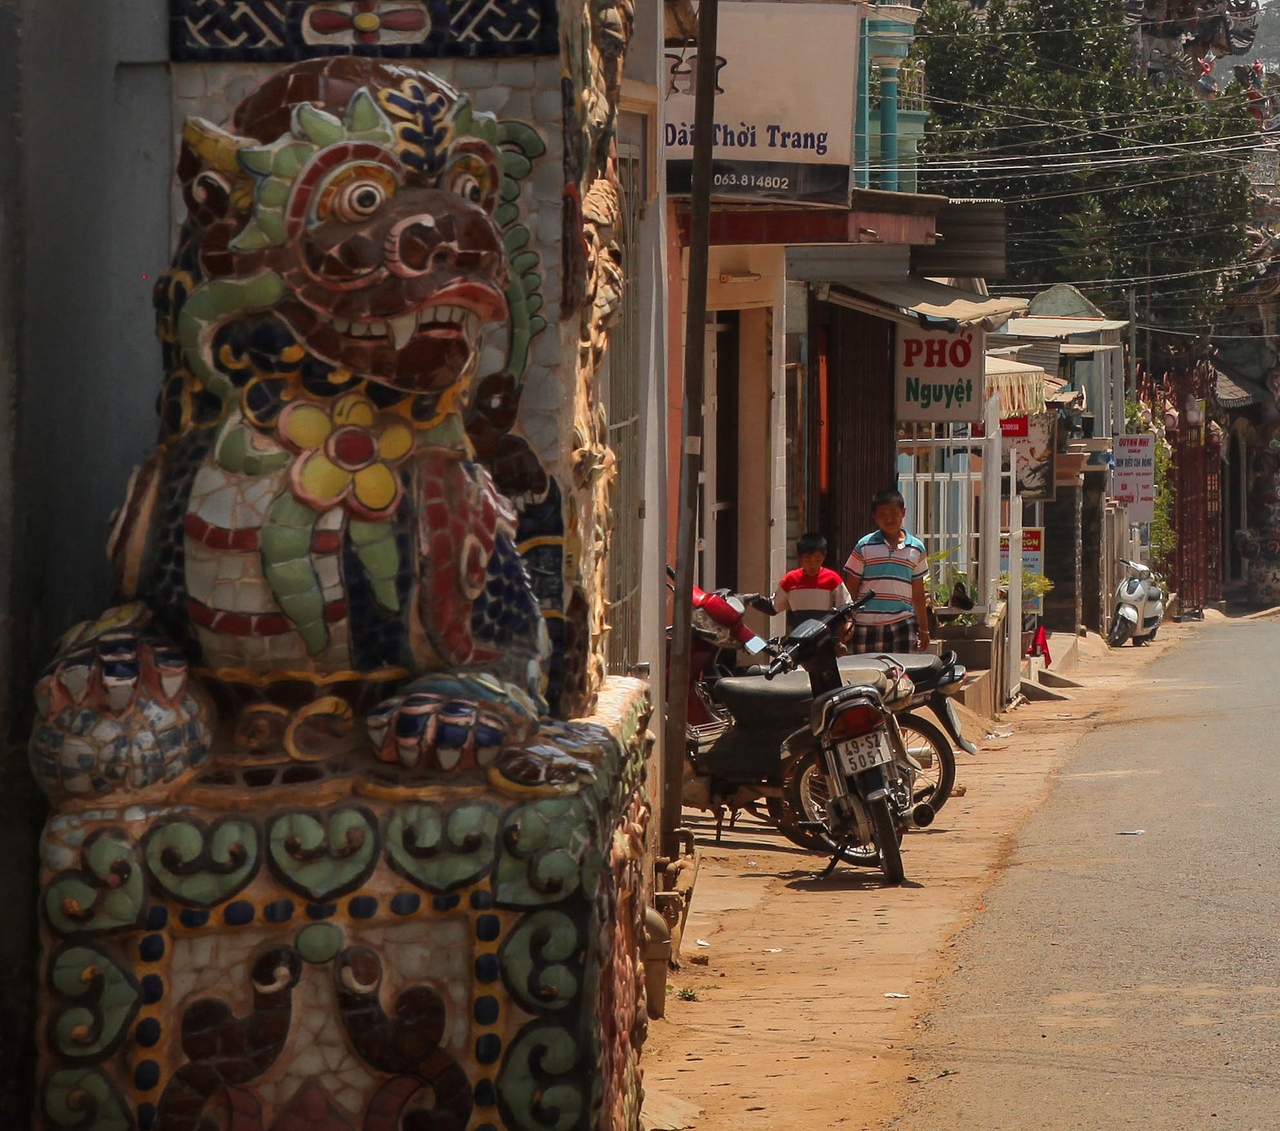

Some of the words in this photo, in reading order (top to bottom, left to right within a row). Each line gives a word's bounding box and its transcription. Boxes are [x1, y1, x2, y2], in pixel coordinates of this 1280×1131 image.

[713, 122, 757, 147] Thời
[766, 125, 828, 155] Trang
[713, 174, 789, 189] 063.814802
[905, 377, 973, 409] Nguyệt
[848, 749, 884, 771] 5051
